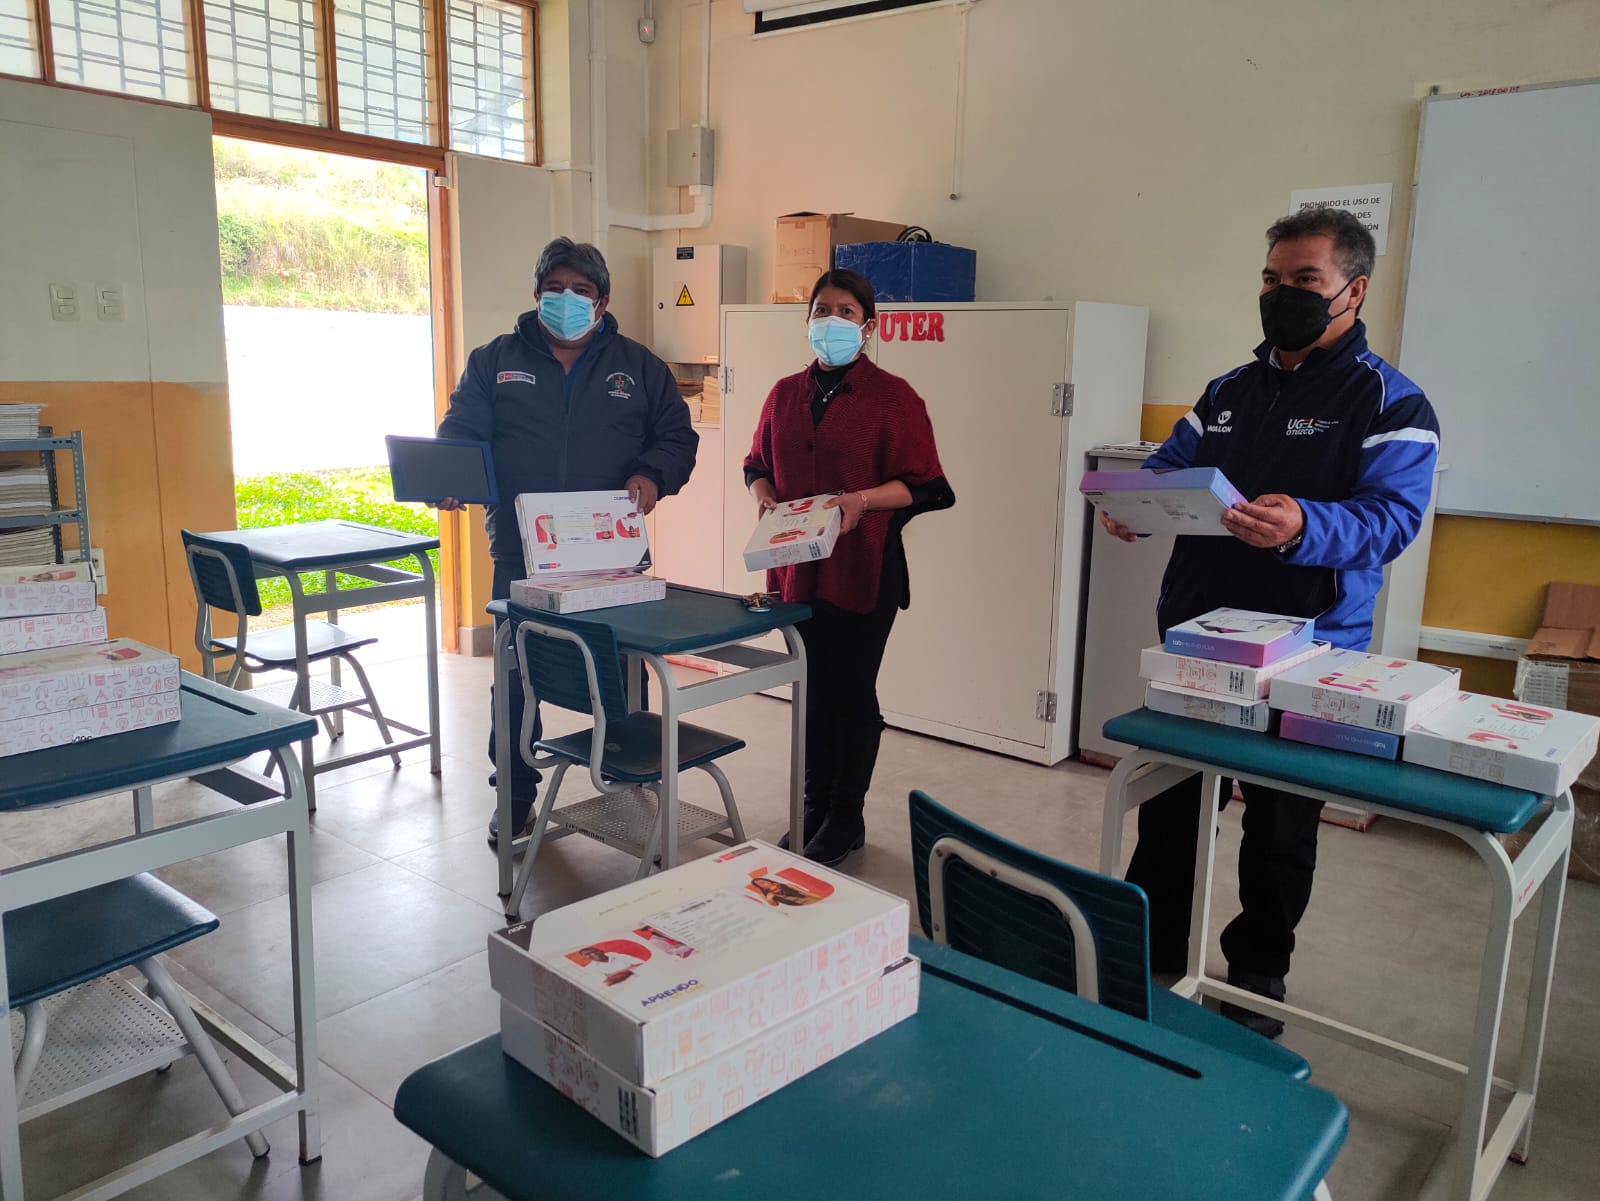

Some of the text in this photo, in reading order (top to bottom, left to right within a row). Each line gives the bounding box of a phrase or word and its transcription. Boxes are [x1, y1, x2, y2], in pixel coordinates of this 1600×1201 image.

[1300, 200, 1341, 209] PROHIBIDO
[1353, 211, 1372, 219] ADES
[1364, 223, 1379, 231] IÓN
[877, 311, 945, 342] UTER
[1207, 425, 1232, 433] WALON
[641, 979, 699, 1008] APRENDO
